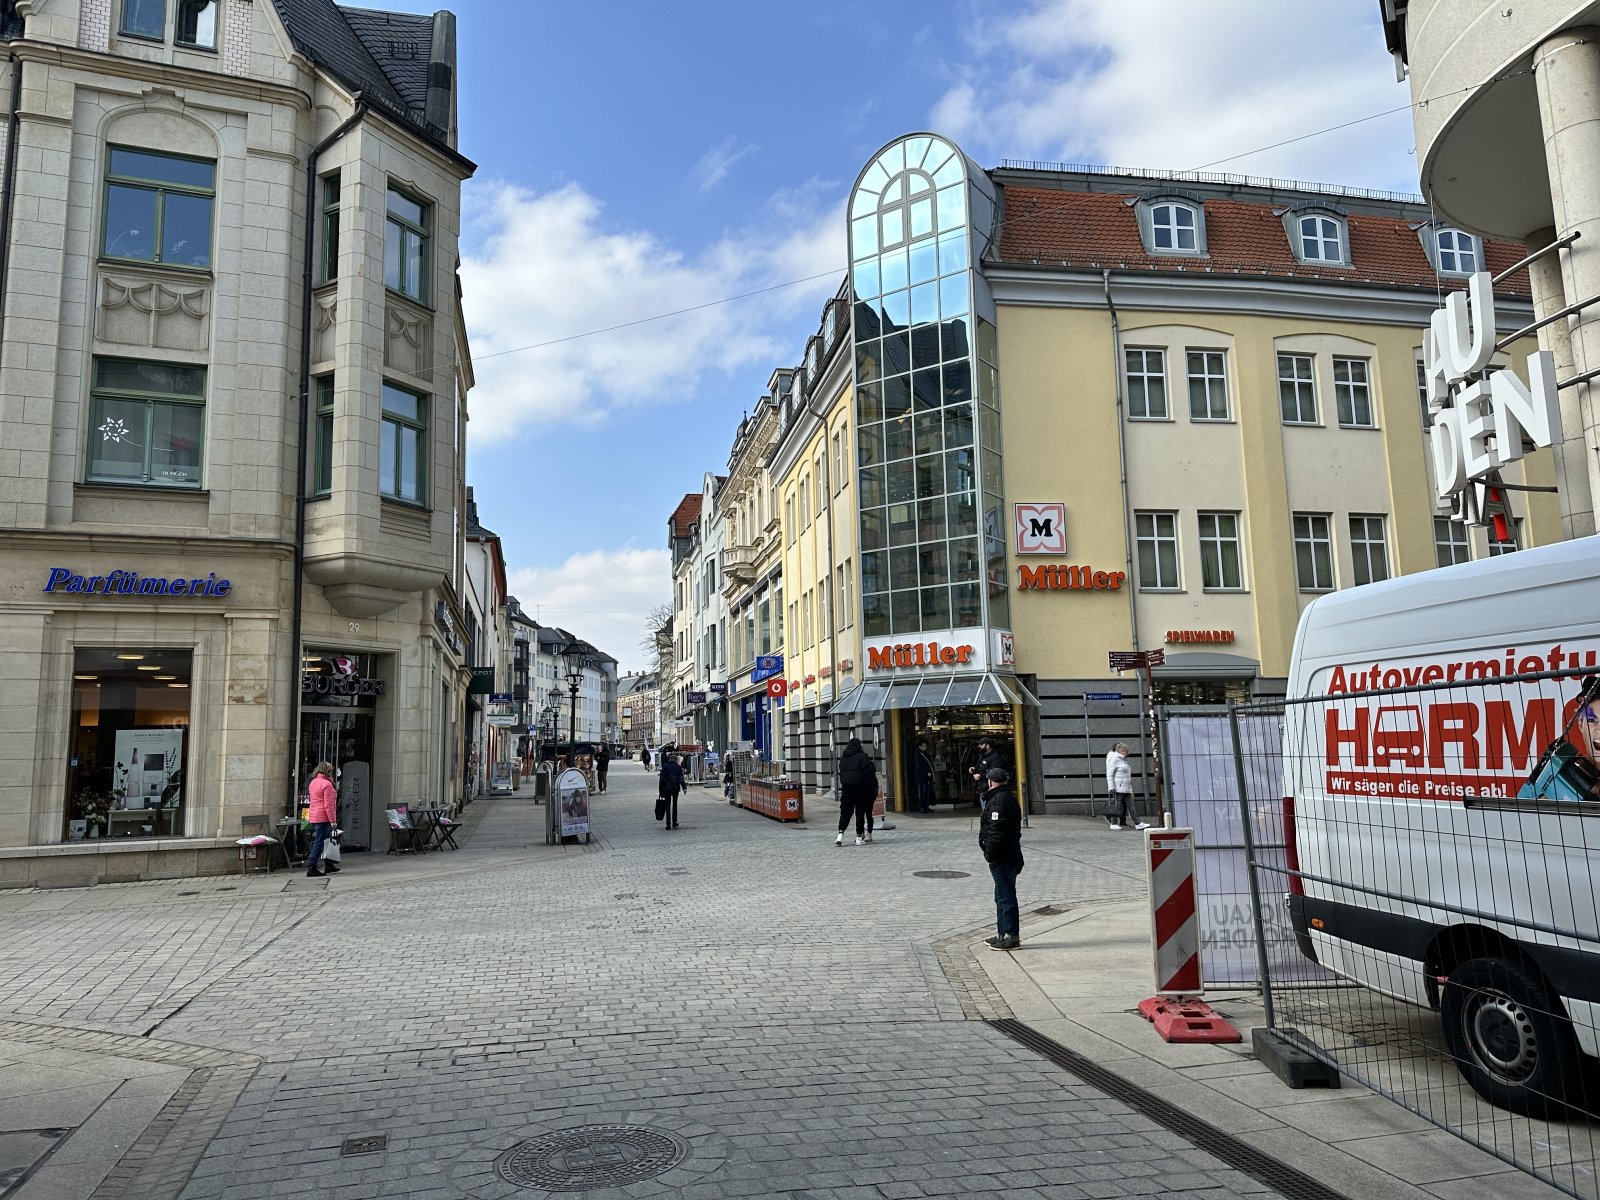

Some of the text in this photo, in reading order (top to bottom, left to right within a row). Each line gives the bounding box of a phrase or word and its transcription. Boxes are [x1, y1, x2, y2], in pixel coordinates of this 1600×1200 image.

[1029, 518, 1053, 538] M
[42, 566, 232, 597] Parfümerie
[1017, 565, 1126, 592] Müller
[349, 622, 359, 632] 29
[1165, 630, 1235, 644] SPIELWAREN
[868, 642, 972, 670] Müller
[302, 672, 385, 696] BURGER
[1331, 777, 1507, 798] Wir sägen die Preise ab!
